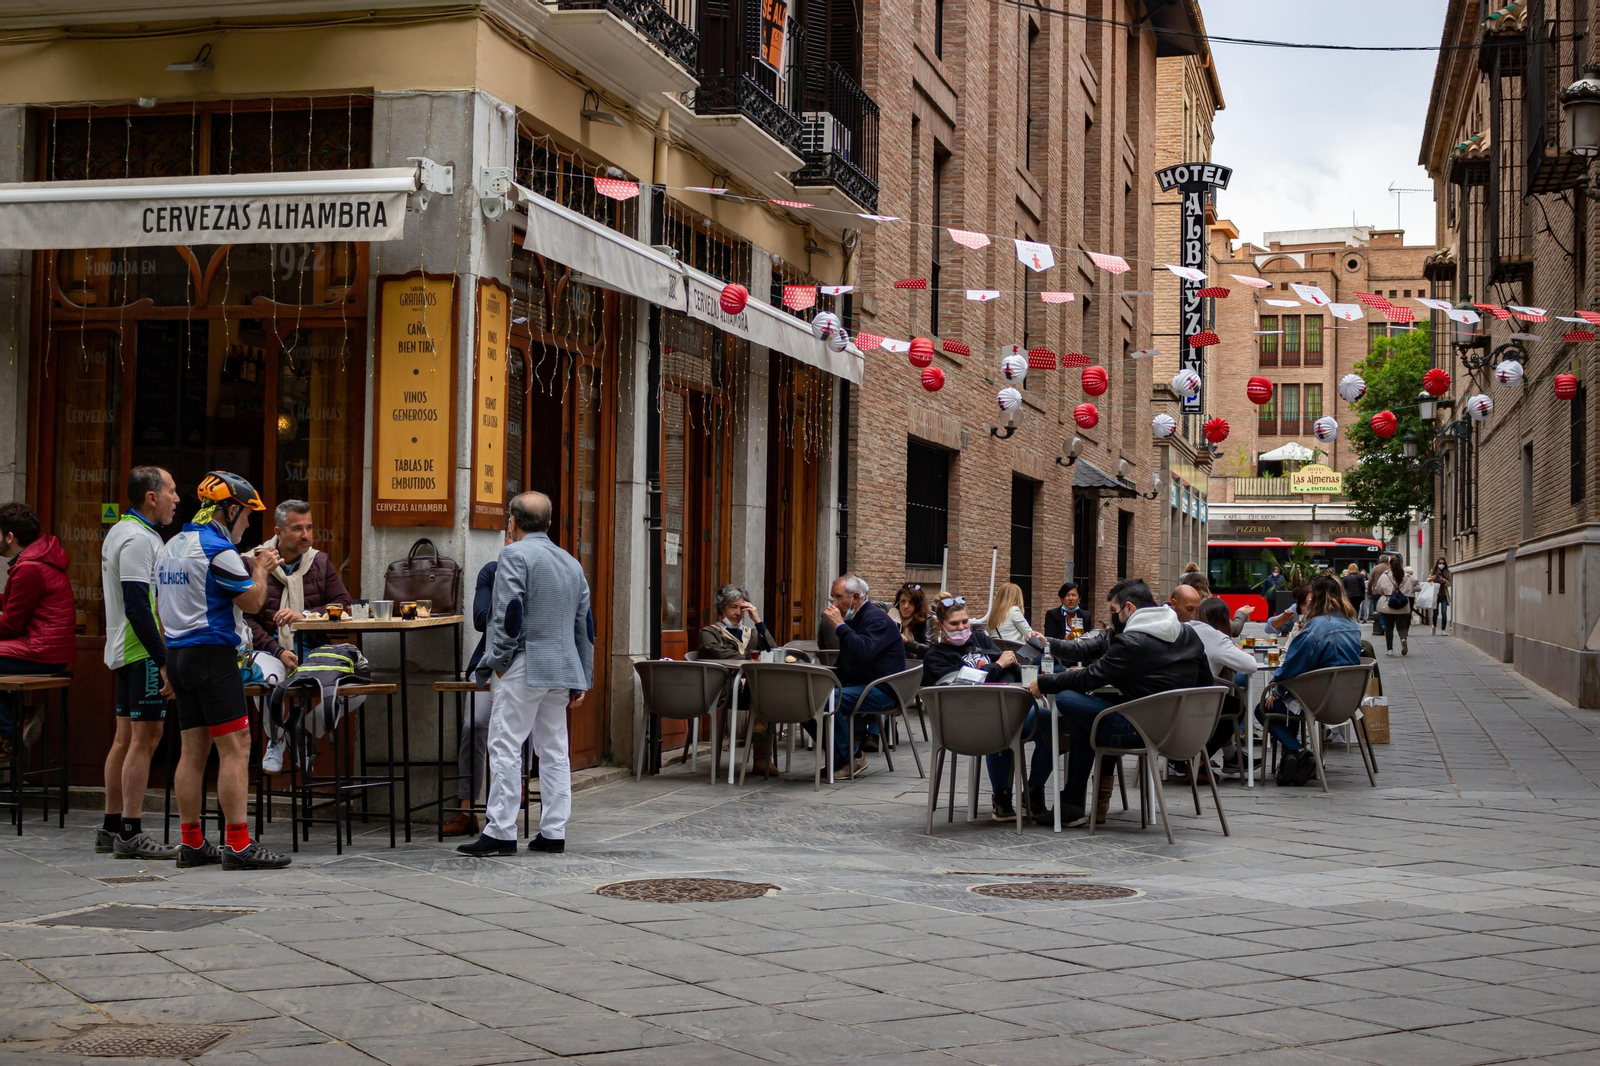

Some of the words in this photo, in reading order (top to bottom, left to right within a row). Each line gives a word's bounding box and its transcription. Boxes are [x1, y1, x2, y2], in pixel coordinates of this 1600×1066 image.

[1160, 166, 1226, 188] HOTEL
[142, 203, 251, 233] CERVEZAS
[257, 201, 388, 230] ALHAMBRA
[86, 255, 138, 276] FUNDADA
[141, 260, 156, 274] EN
[272, 242, 326, 281] 1922
[400, 292, 437, 306] GRANADOS
[694, 289, 720, 320] CERVEZAS
[398, 341, 416, 353] BIEN
[404, 390, 427, 404] VINOS
[65, 404, 114, 424] CERVEZAS
[392, 408, 438, 422] GENEROSOS
[68, 462, 108, 482] VERMUT
[284, 460, 346, 482] SALAZONES
[394, 459, 422, 472] TABLAS
[424, 459, 434, 472] DE
[392, 476, 436, 490] EMBUTIDOS
[376, 503, 409, 512] CERVEZAS
[410, 504, 448, 512] ALHAMBRA
[60, 521, 107, 540] OLOROSO
[312, 528, 336, 542] ESOS
